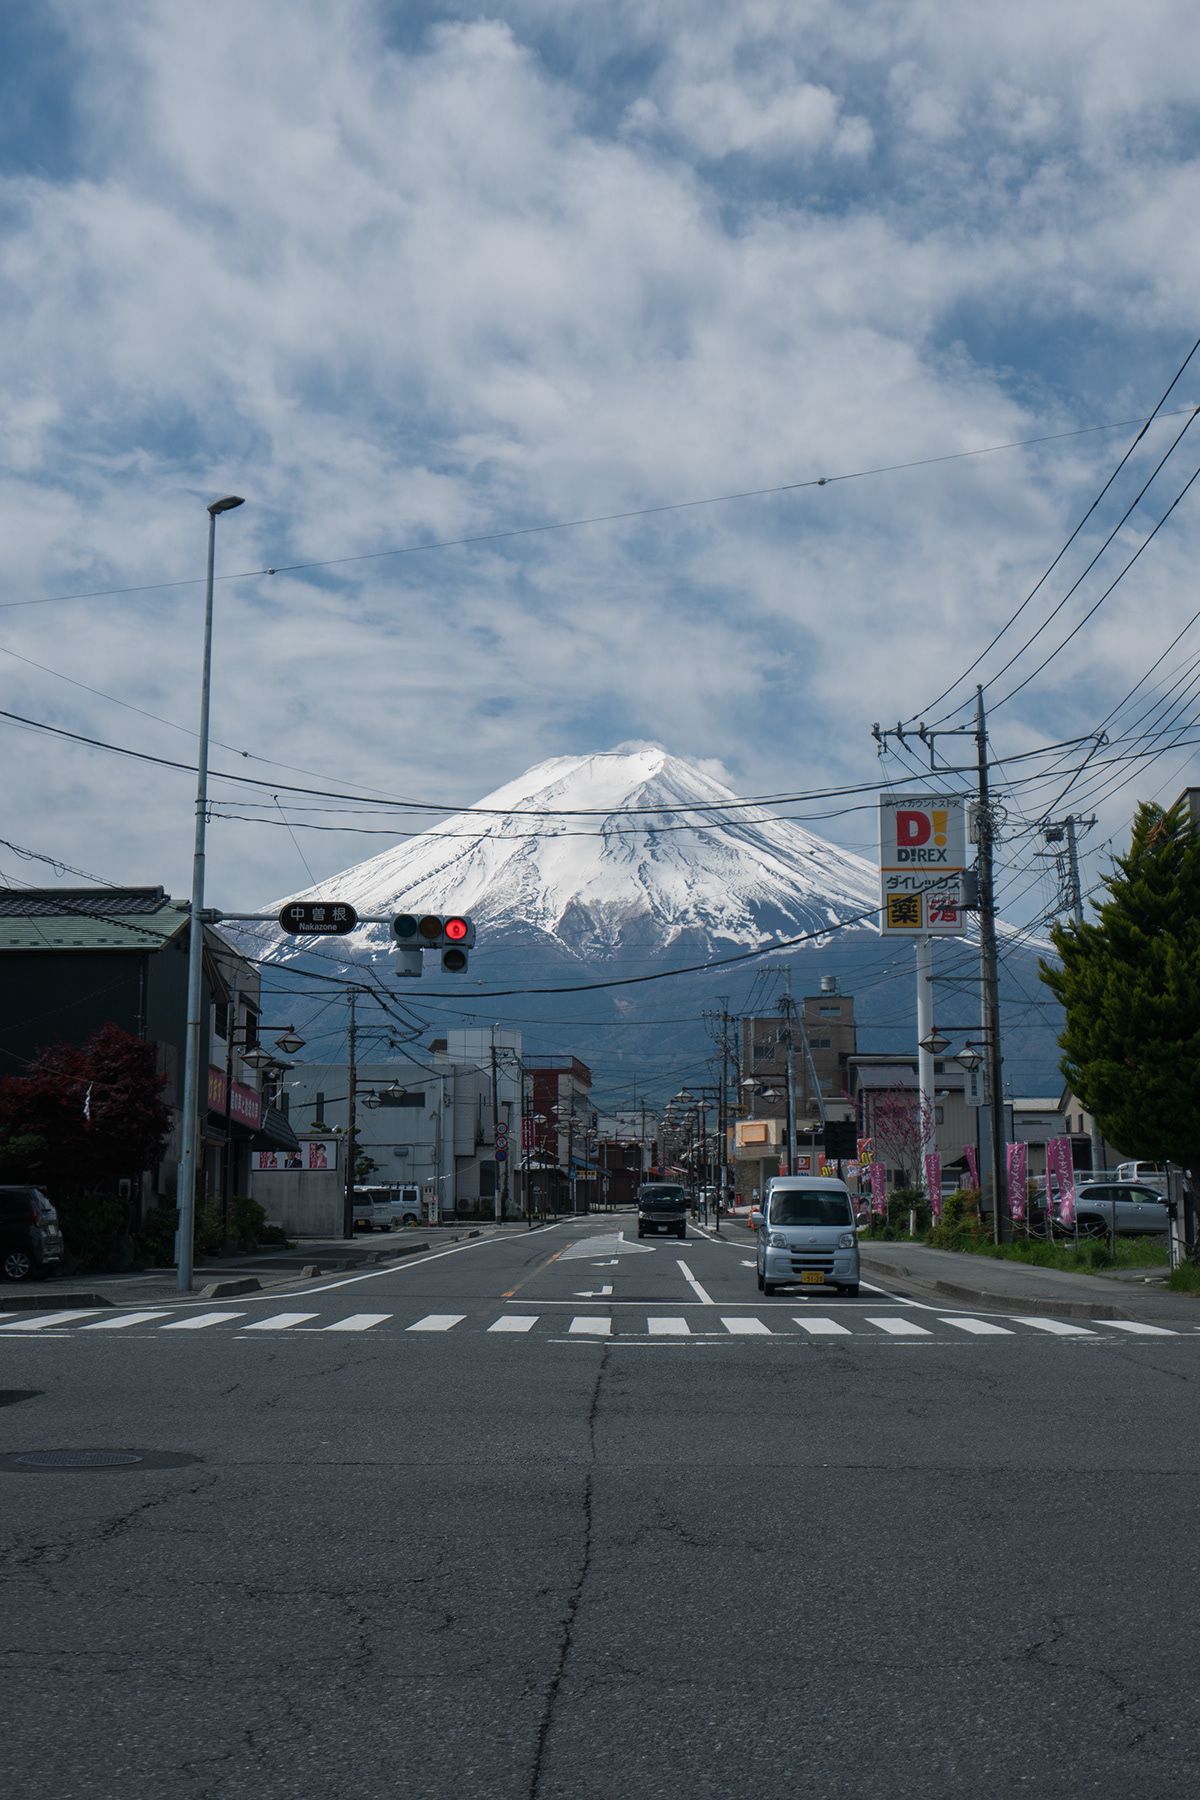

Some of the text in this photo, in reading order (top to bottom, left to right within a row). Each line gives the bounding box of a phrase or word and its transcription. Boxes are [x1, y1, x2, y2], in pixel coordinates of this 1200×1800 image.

[290, 906, 347, 921] 中曽根
[299, 922, 338, 931] Nakazone
